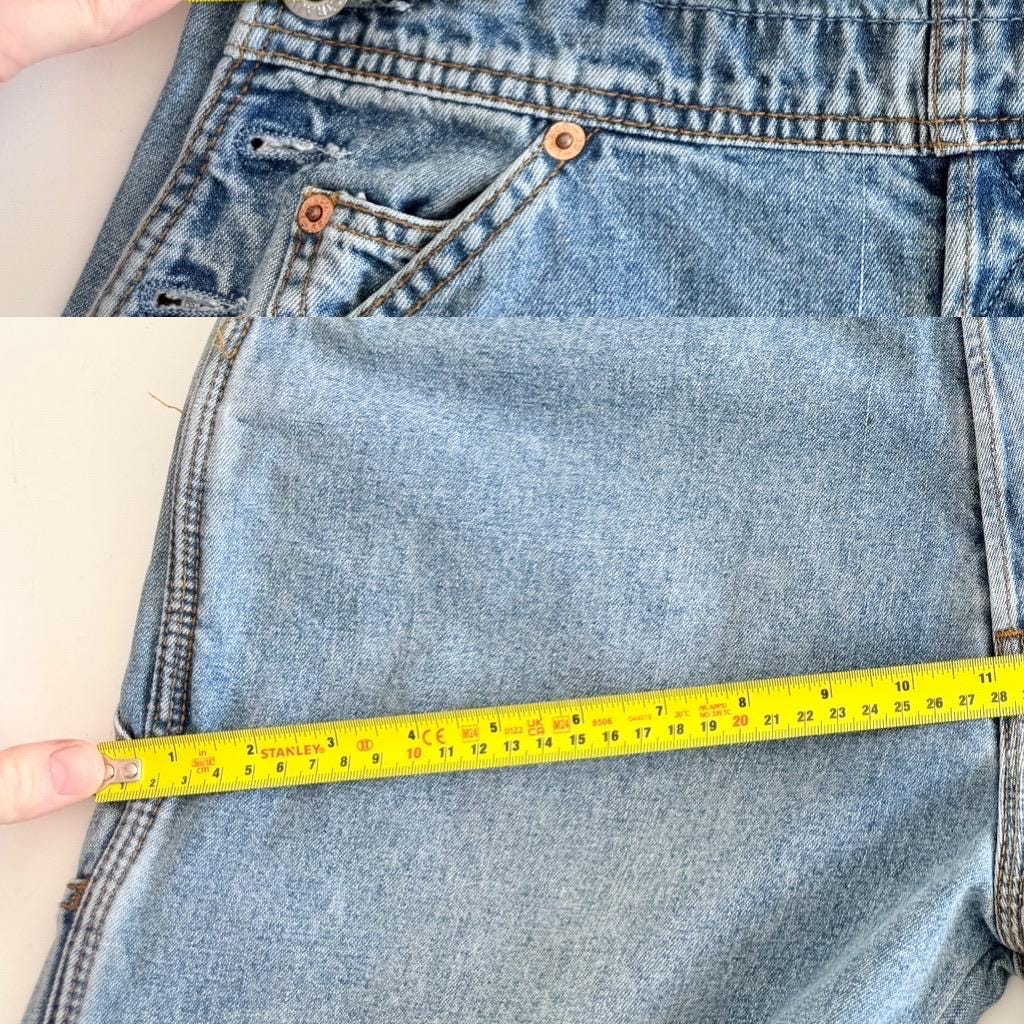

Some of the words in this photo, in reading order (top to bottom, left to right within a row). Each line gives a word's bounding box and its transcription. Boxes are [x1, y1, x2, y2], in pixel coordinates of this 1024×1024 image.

[407, 748, 421, 759] 10
[732, 716, 748, 727] 20
[895, 702, 910, 712] 25
[422, 729, 444, 745] CE
